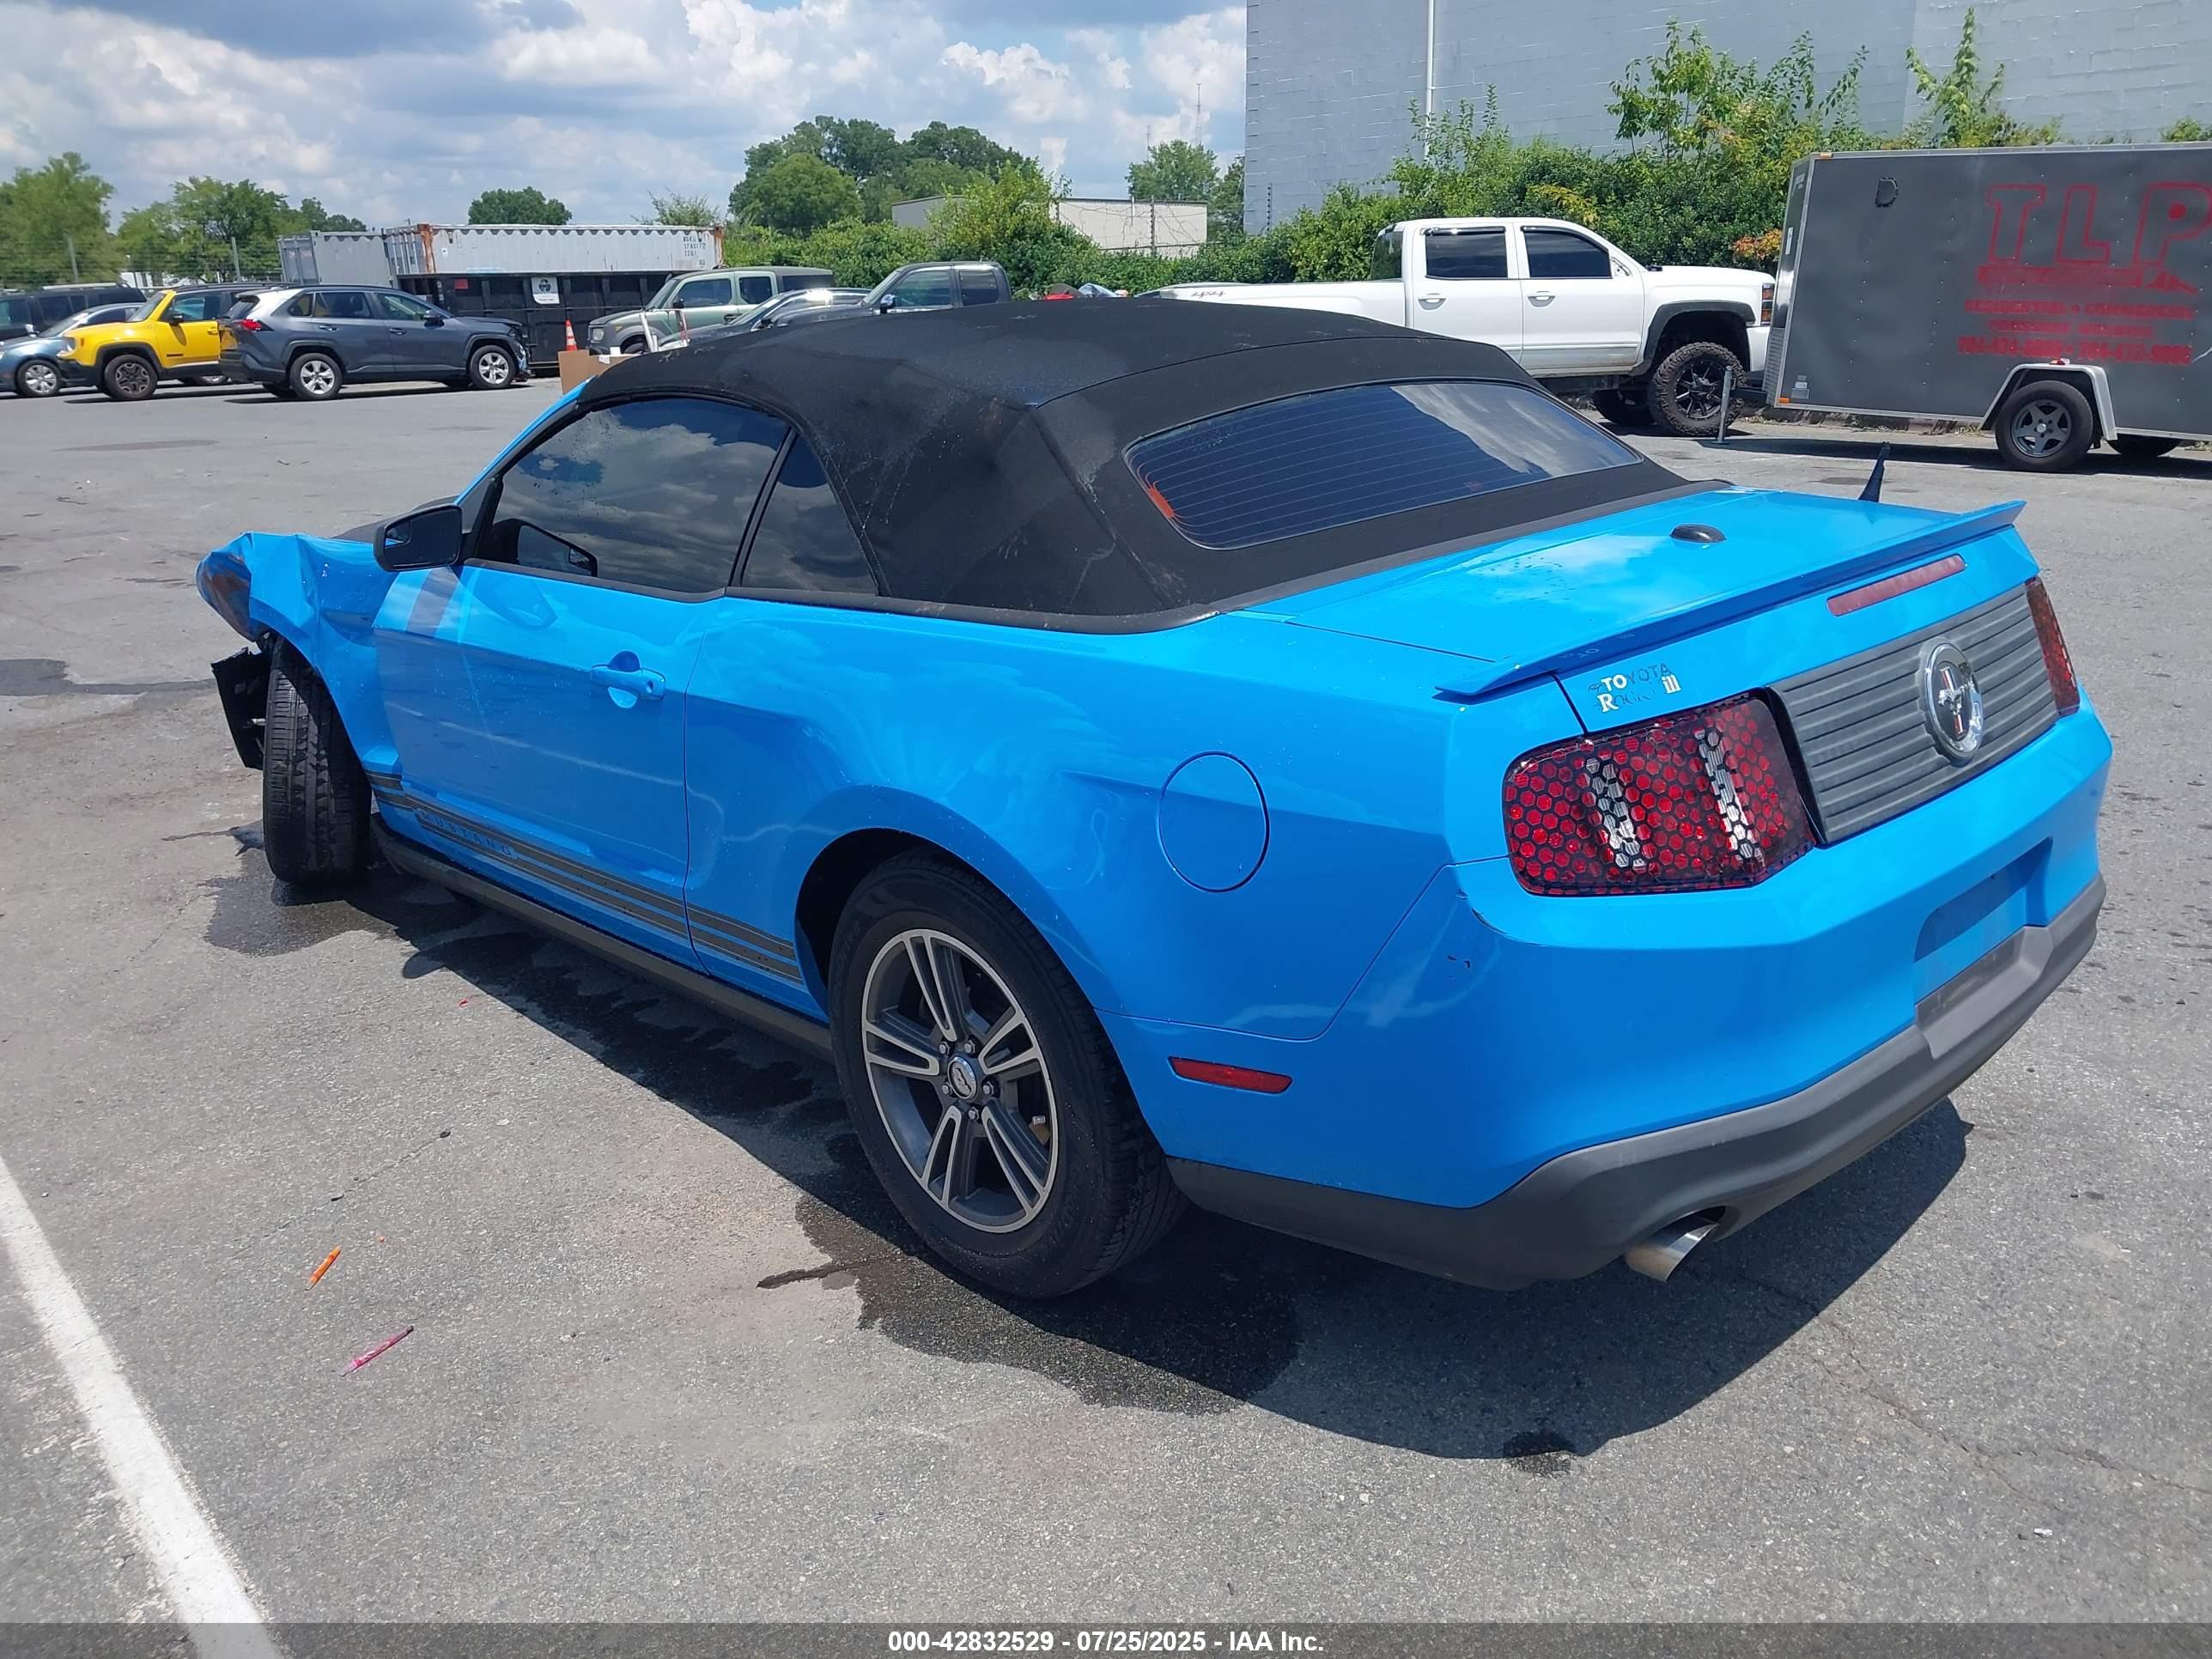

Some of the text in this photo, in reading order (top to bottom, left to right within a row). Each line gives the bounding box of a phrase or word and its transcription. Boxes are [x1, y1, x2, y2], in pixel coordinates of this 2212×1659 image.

[1985, 181, 2212, 267] TLP
[1601, 663, 1673, 692] TOYOTA
[420, 809, 514, 856] MUSTANG
